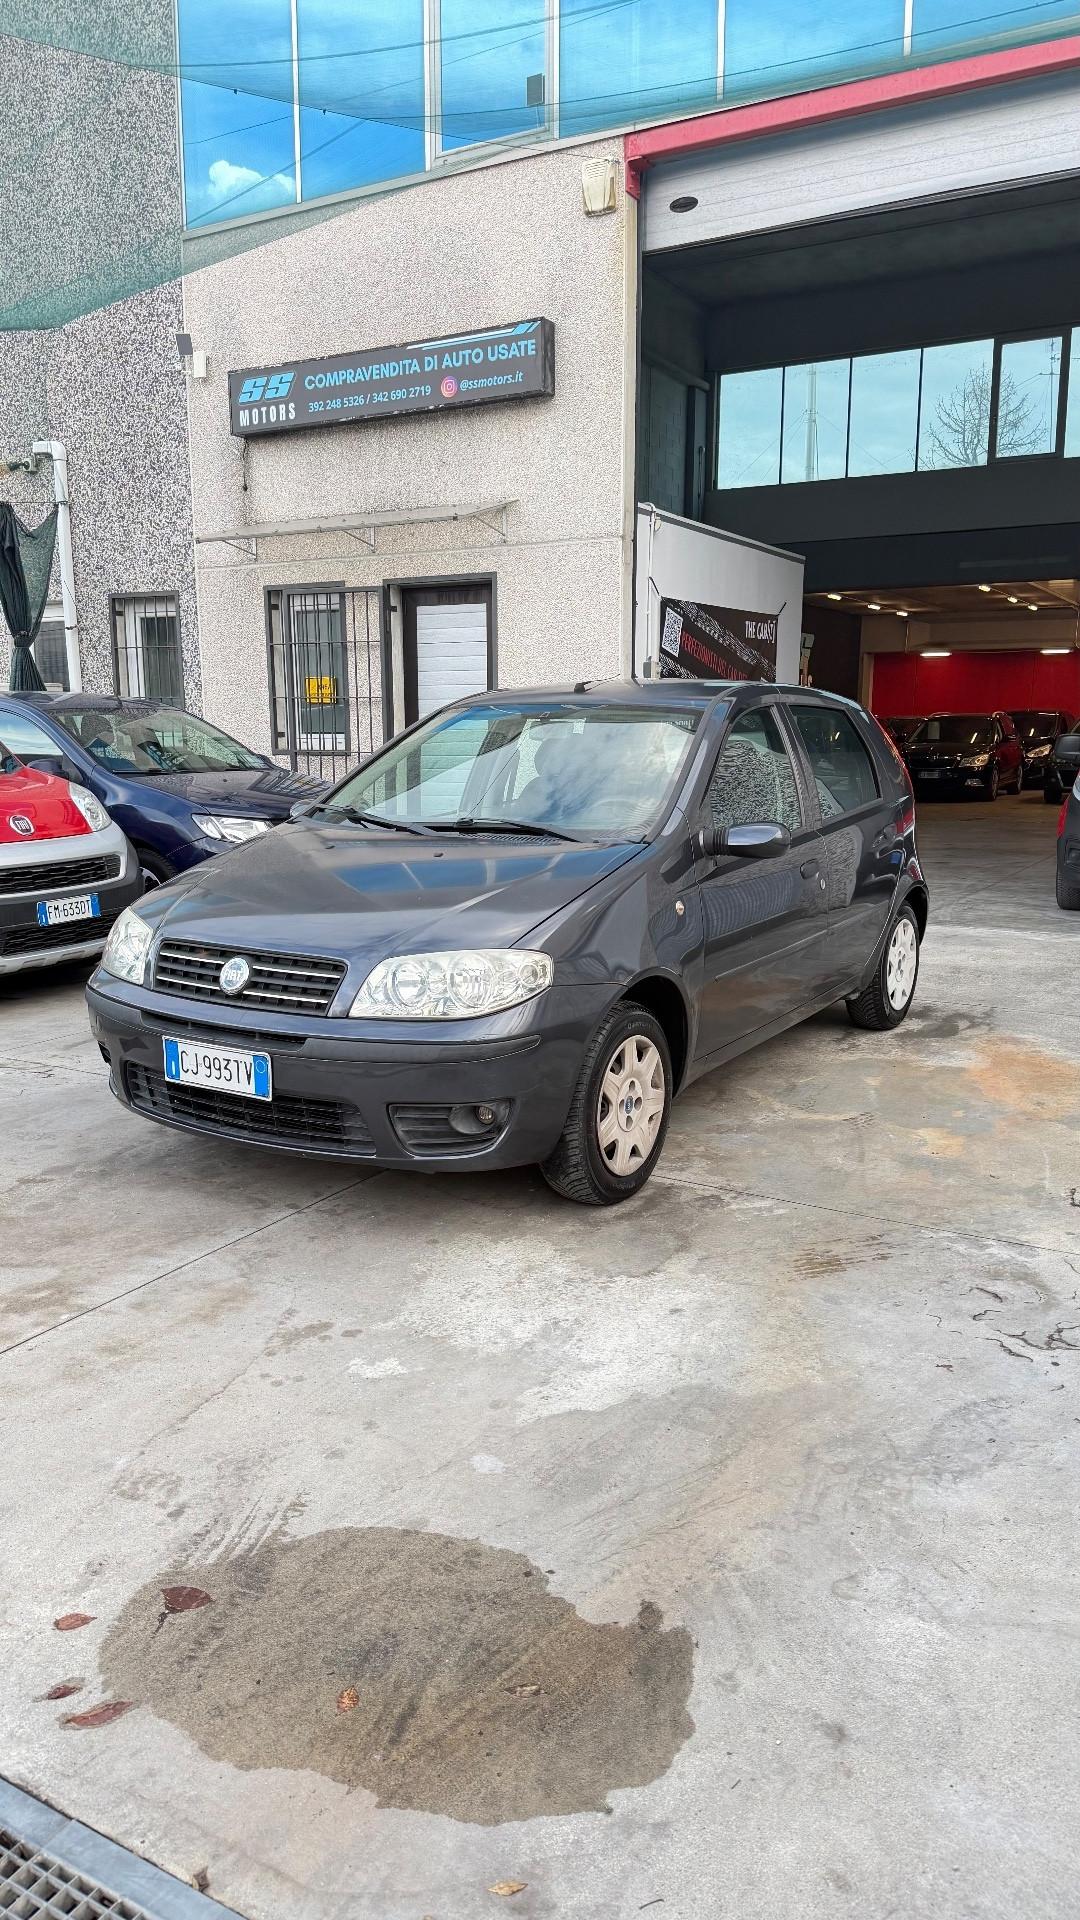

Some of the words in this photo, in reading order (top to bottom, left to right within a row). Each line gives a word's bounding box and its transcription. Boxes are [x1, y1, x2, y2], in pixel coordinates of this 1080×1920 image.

[304, 358, 421, 390] COMPRAVENDITA
[424, 355, 438, 372] DI
[442, 348, 484, 370] AUTO
[487, 339, 537, 362] USATE
[238, 371, 296, 404] SS
[459, 370, 524, 392] @ssmotors.it
[308, 401, 324, 413] 392
[326, 398, 342, 410] 248
[343, 394, 365, 408] 5326
[372, 390, 389, 403] 342
[390, 387, 407, 401] 690
[408, 385, 432, 399] 2719
[239, 402, 296, 427] MOTORS
[745, 620, 756, 639] THE
[223, 969, 244, 982] FIAT
